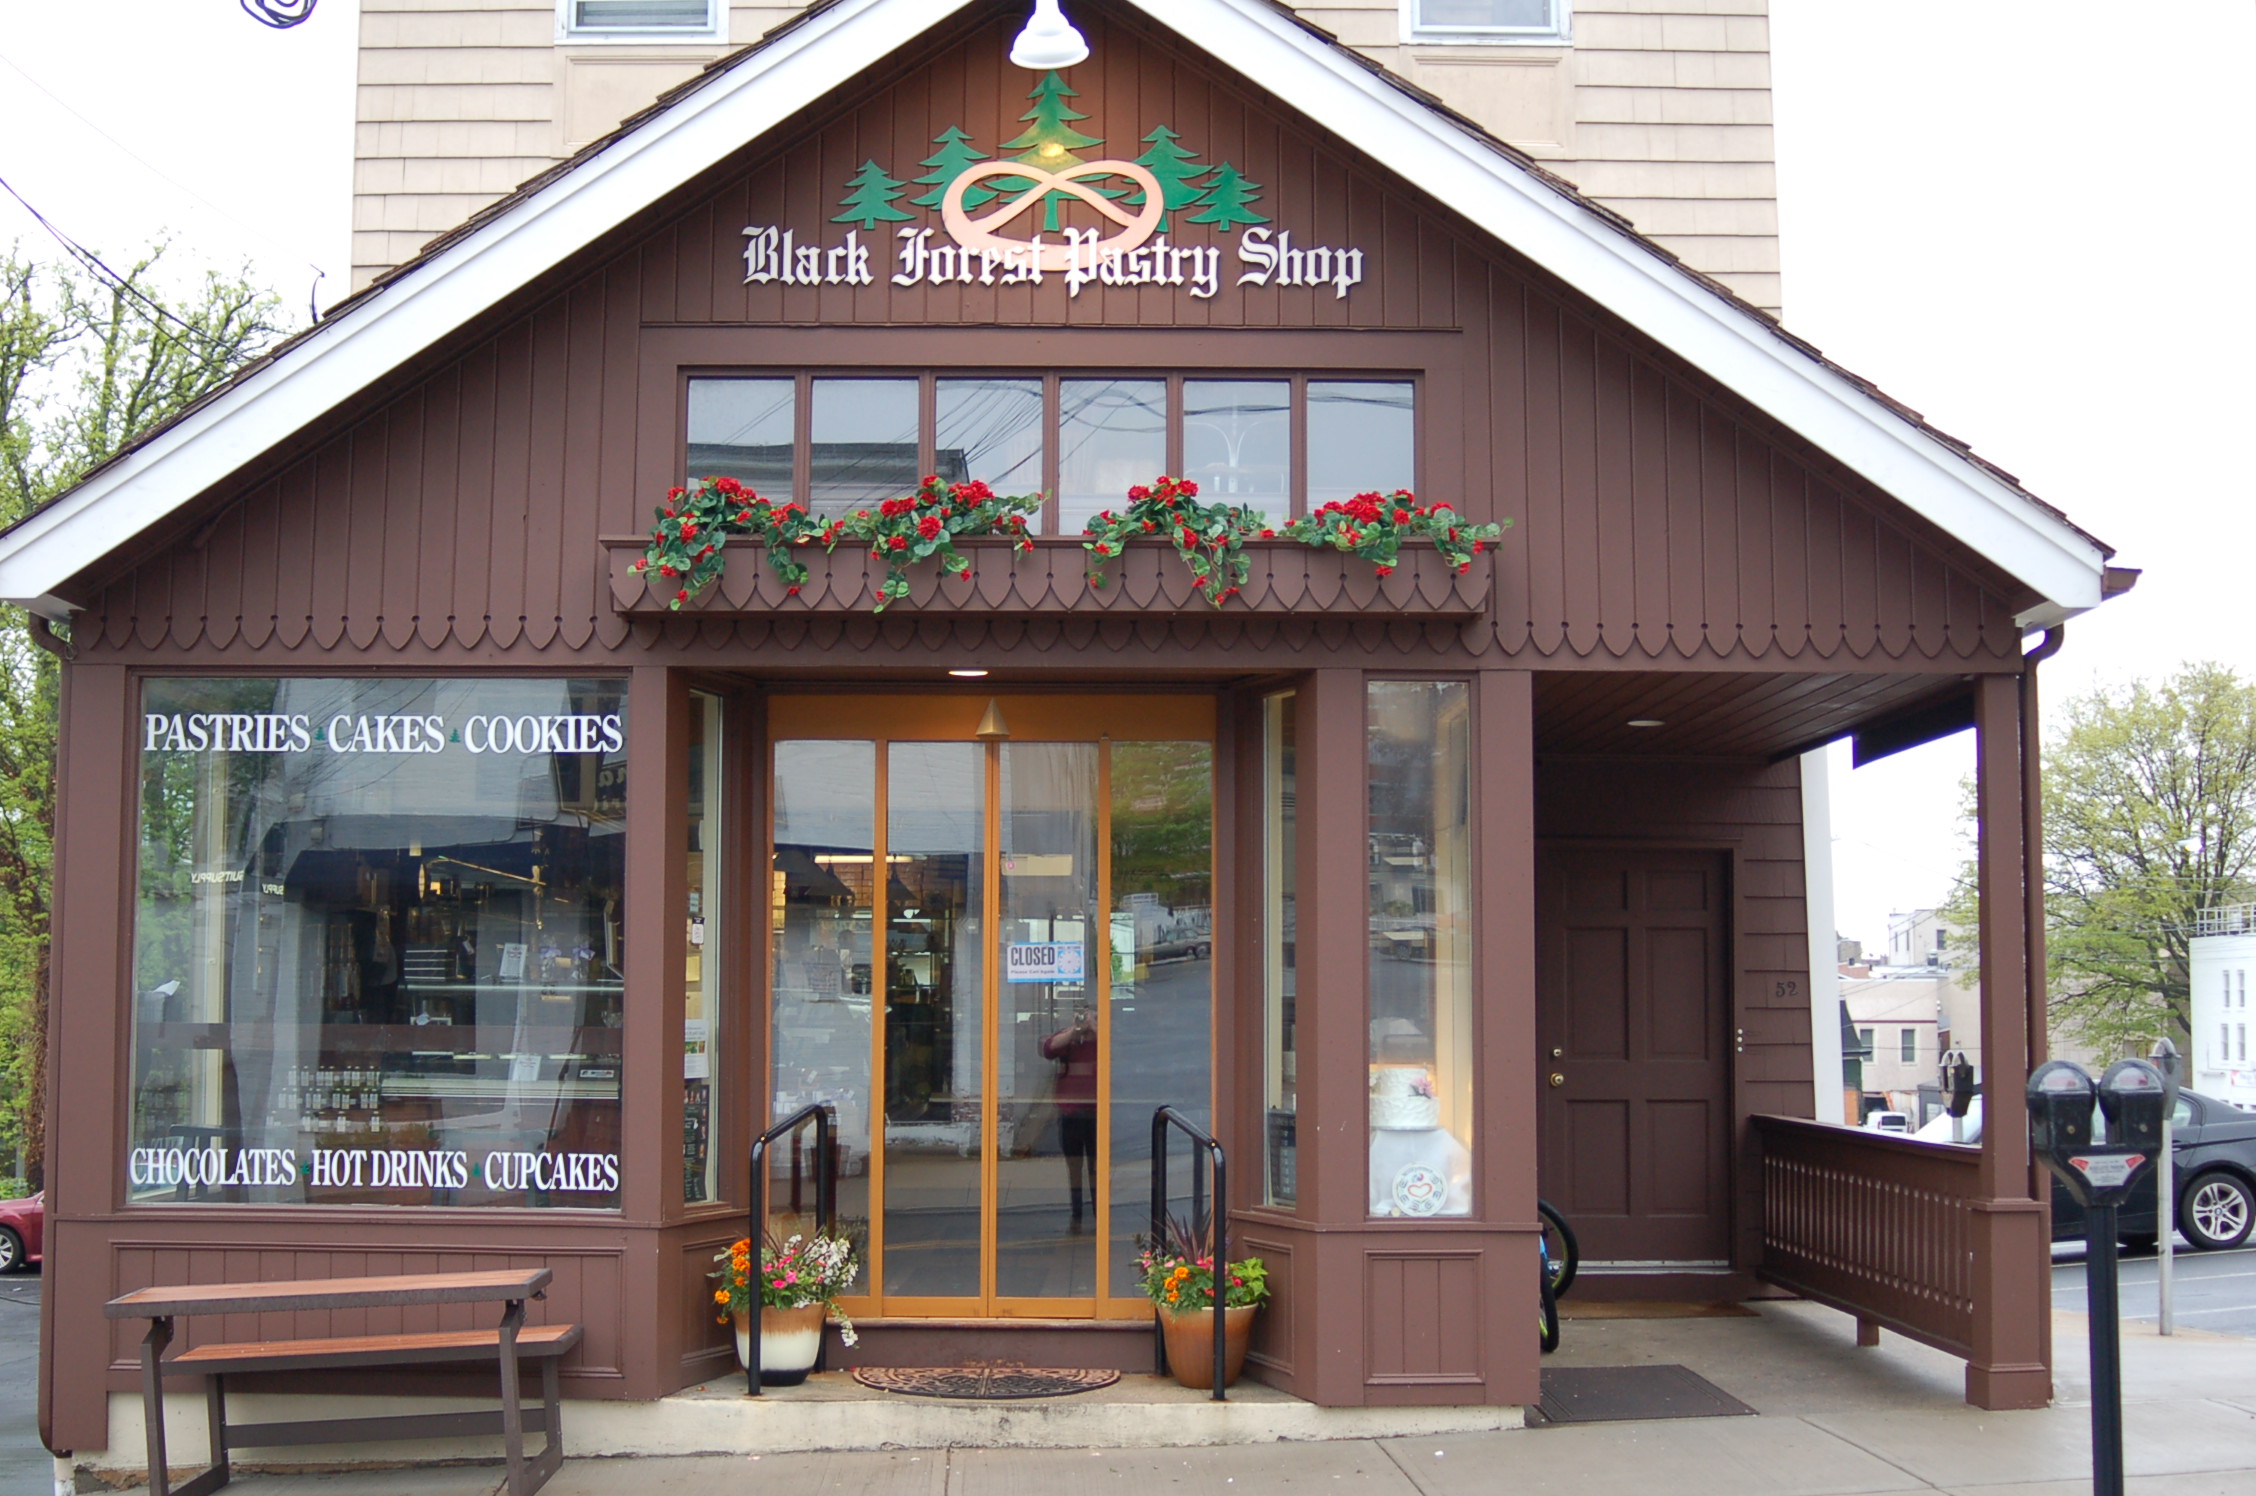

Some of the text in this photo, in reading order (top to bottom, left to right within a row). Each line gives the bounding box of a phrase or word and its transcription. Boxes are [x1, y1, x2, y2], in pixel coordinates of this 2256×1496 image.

[742, 225, 1364, 298] Black Forest Pastry Shop
[145, 713, 623, 754] PASTRIES CAKES COOKIES
[1011, 946, 1056, 966] CLOSED
[1775, 981, 1800, 998] 52
[129, 1147, 619, 1192] CHOCOLATES HOT DRINKS CUPCAKES
